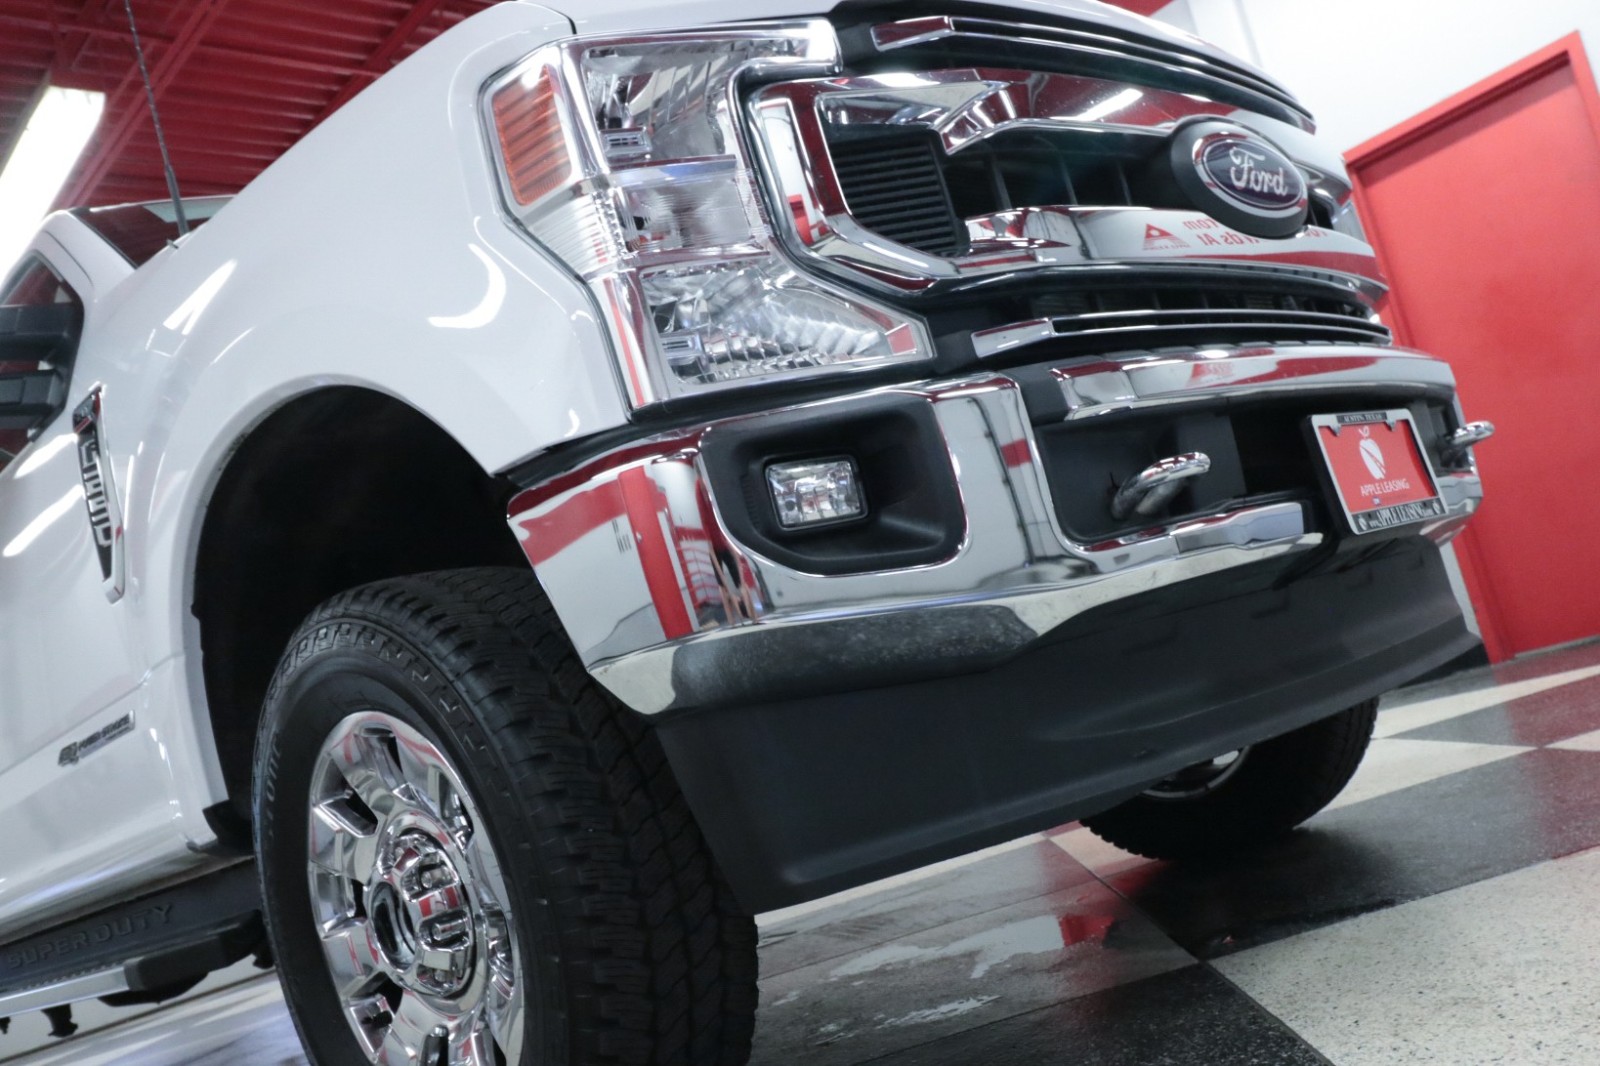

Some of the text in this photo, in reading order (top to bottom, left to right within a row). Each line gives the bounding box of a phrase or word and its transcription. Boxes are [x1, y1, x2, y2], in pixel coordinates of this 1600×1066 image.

[1229, 146, 1288, 197] Ford
[1360, 479, 1410, 496] APPLE LEASING
[7, 901, 174, 970] SUPER DUTY
